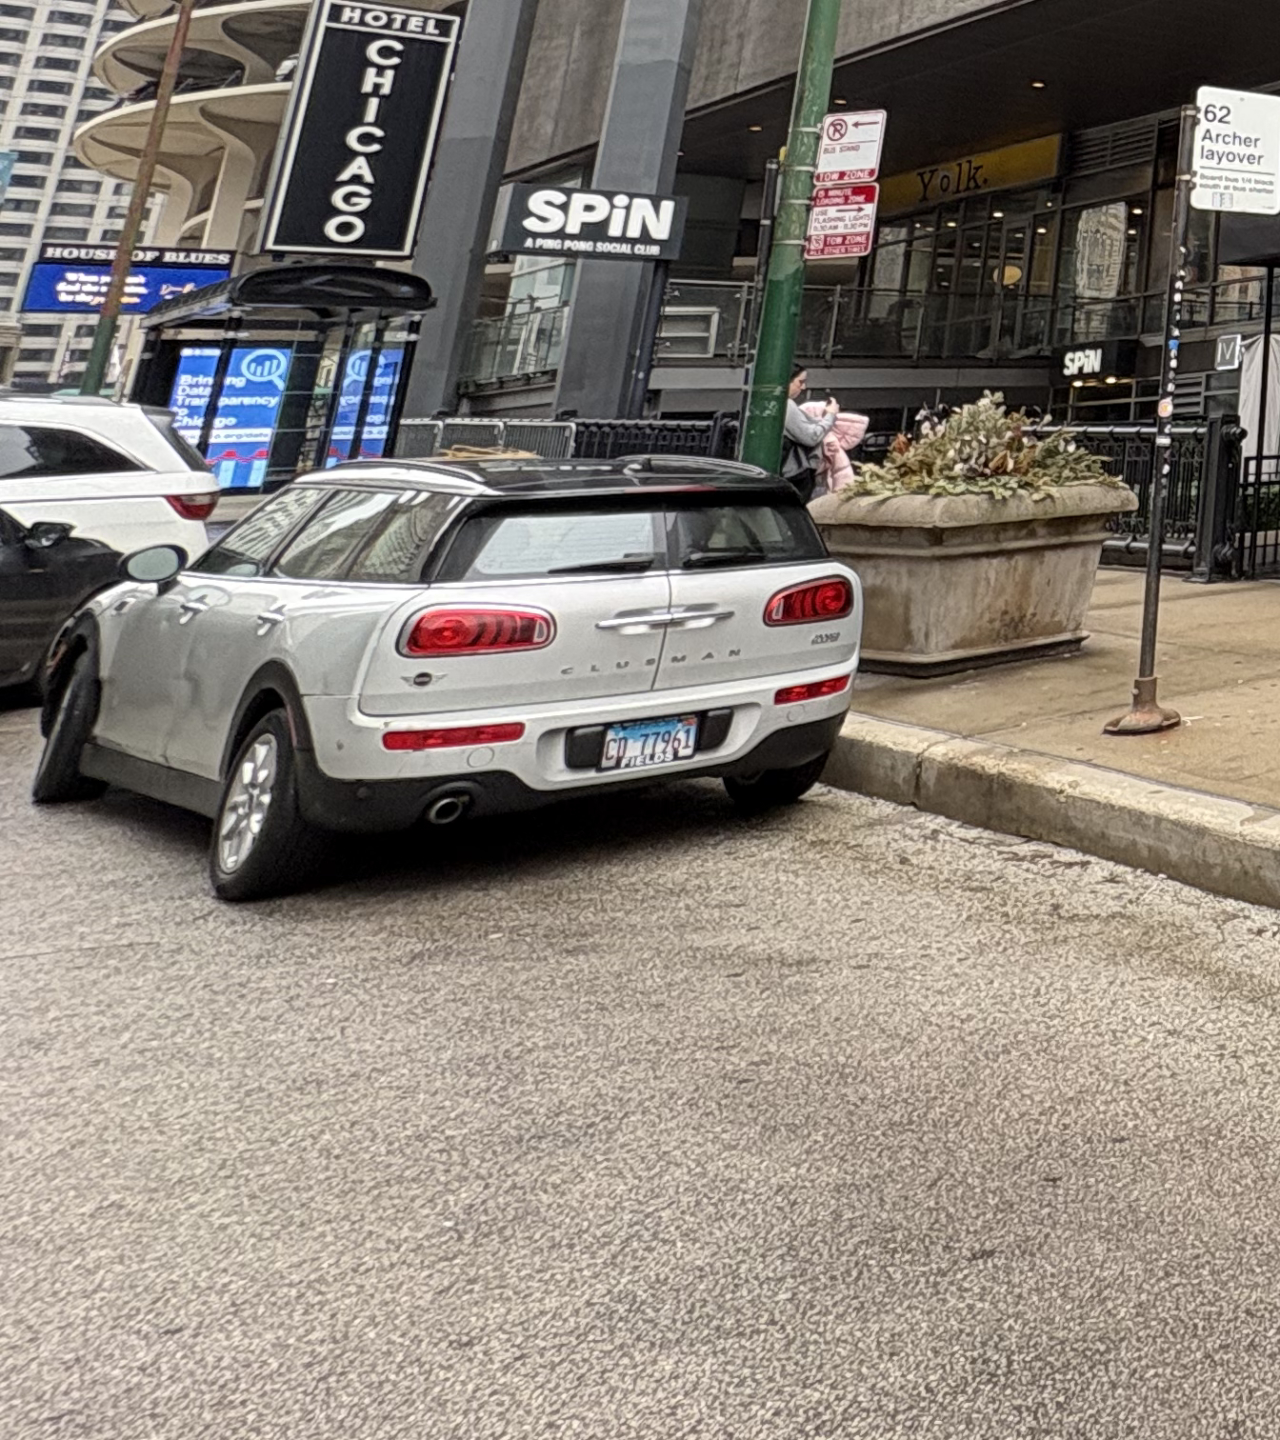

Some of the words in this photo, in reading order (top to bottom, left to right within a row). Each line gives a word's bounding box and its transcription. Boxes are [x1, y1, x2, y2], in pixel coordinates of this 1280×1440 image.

[340, 7, 440, 35] HOTEL
[1204, 103, 1231, 124] 62
[323, 39, 404, 243] CHICAGO
[1201, 128, 1261, 148] Archer
[823, 146, 836, 154] BUS
[839, 144, 861, 153] STAND
[1200, 145, 1264, 165] layover
[818, 172, 840, 182] TOW
[844, 170, 871, 179] ZONE
[1224, 175, 1239, 183] bus
[1254, 177, 1274, 186] block
[1199, 182, 1221, 190] south
[1223, 183, 1231, 191] at
[1232, 184, 1247, 192] bus
[1248, 185, 1274, 194] shelter
[815, 197, 845, 206] LOADING
[813, 216, 847, 225] FLASHING
[848, 214, 871, 222] LIGHTS
[814, 209, 828, 217] USE
[826, 236, 843, 245] TOW
[845, 234, 867, 244] ZONE
[524, 238, 533, 248] A
[535, 238, 562, 251] PING
[563, 240, 594, 253] PONG
[594, 242, 632, 255] SOCIAL
[633, 244, 660, 256] CLUB
[162, 251, 232, 265] BLUES
[640, 727, 692, 757] 77961
[621, 751, 675, 769] FIELDS
